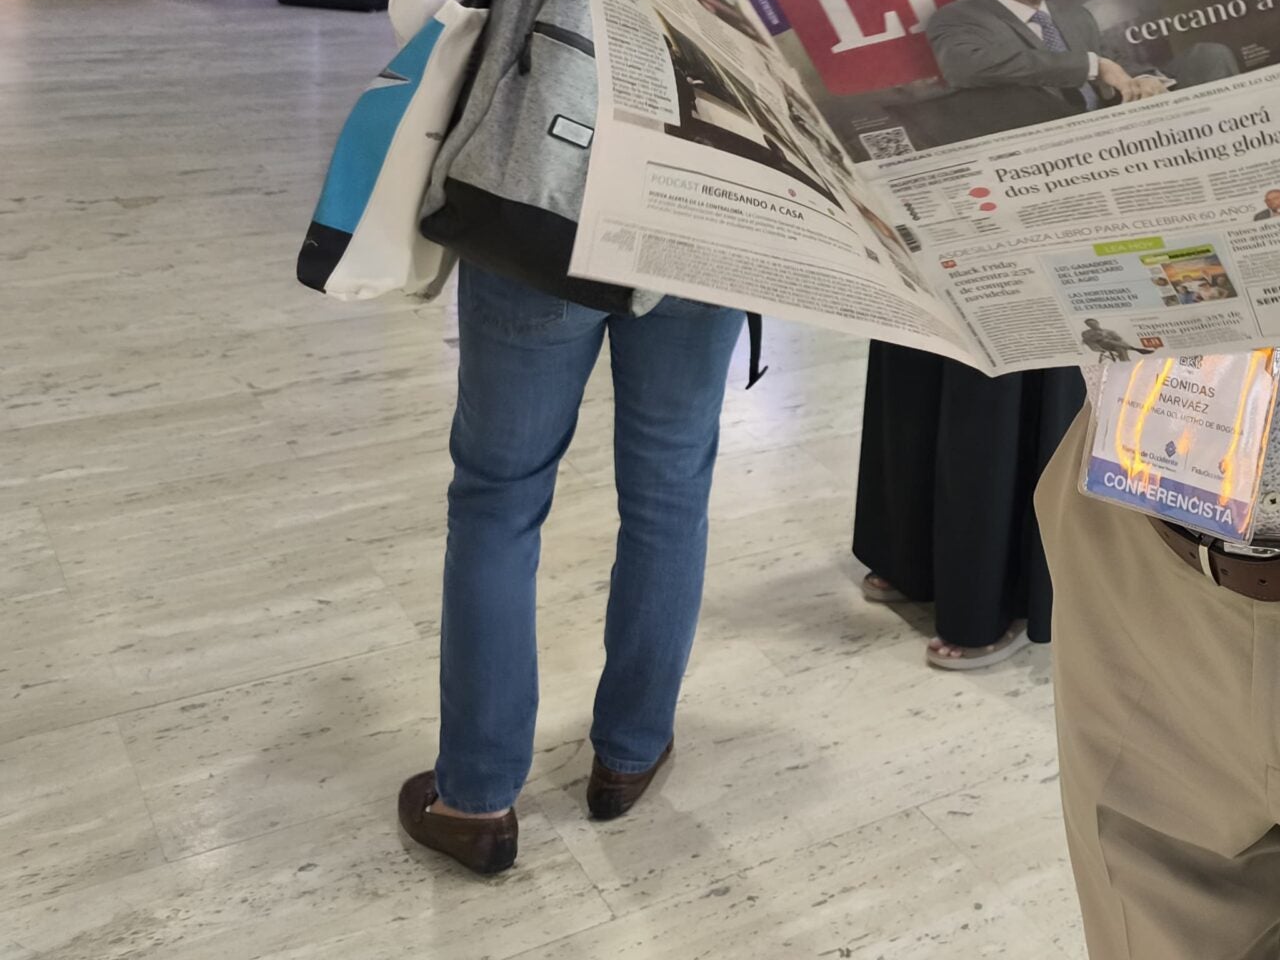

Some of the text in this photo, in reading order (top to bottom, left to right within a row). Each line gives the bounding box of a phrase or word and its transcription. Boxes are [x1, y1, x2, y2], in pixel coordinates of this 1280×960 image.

[1232, 80, 1246, 89] DE
[1248, 76, 1261, 85] LO
[995, 148, 1093, 183] Pasaporte
[1098, 123, 1214, 161] colombiano
[1218, 105, 1271, 135] caerá
[1004, 182, 1041, 199] dos
[1045, 165, 1120, 193] puestos
[1124, 159, 1150, 175] en
[1153, 140, 1230, 168] ranking
[651, 173, 805, 221] PODCAST REGRESANDO A CASA
[1008, 232, 1052, 246] LANZA
[1054, 226, 1093, 239] LIBRO
[1095, 222, 1130, 234] PARA
[1132, 211, 1200, 229] CELEBRAR
[1200, 210, 1216, 221] 60
[1219, 203, 1257, 218] AÑOS
[1232, 241, 1267, 253] Donald
[948, 261, 1017, 279] Black Friday
[1054, 259, 1119, 273] LOS GANADORES
[954, 272, 1009, 286] concentra
[1078, 275, 1099, 283] AGRO
[960, 279, 1024, 295] de compras
[964, 289, 1021, 303] navideñas
[1067, 291, 1083, 299] LAS
[1085, 300, 1133, 311] EXTRANJERO
[1226, 310, 1241, 318] de
[1205, 420, 1215, 430] DE
[1149, 451, 1179, 467] Occidente
[1104, 471, 1233, 525] CONFERENCISTA
